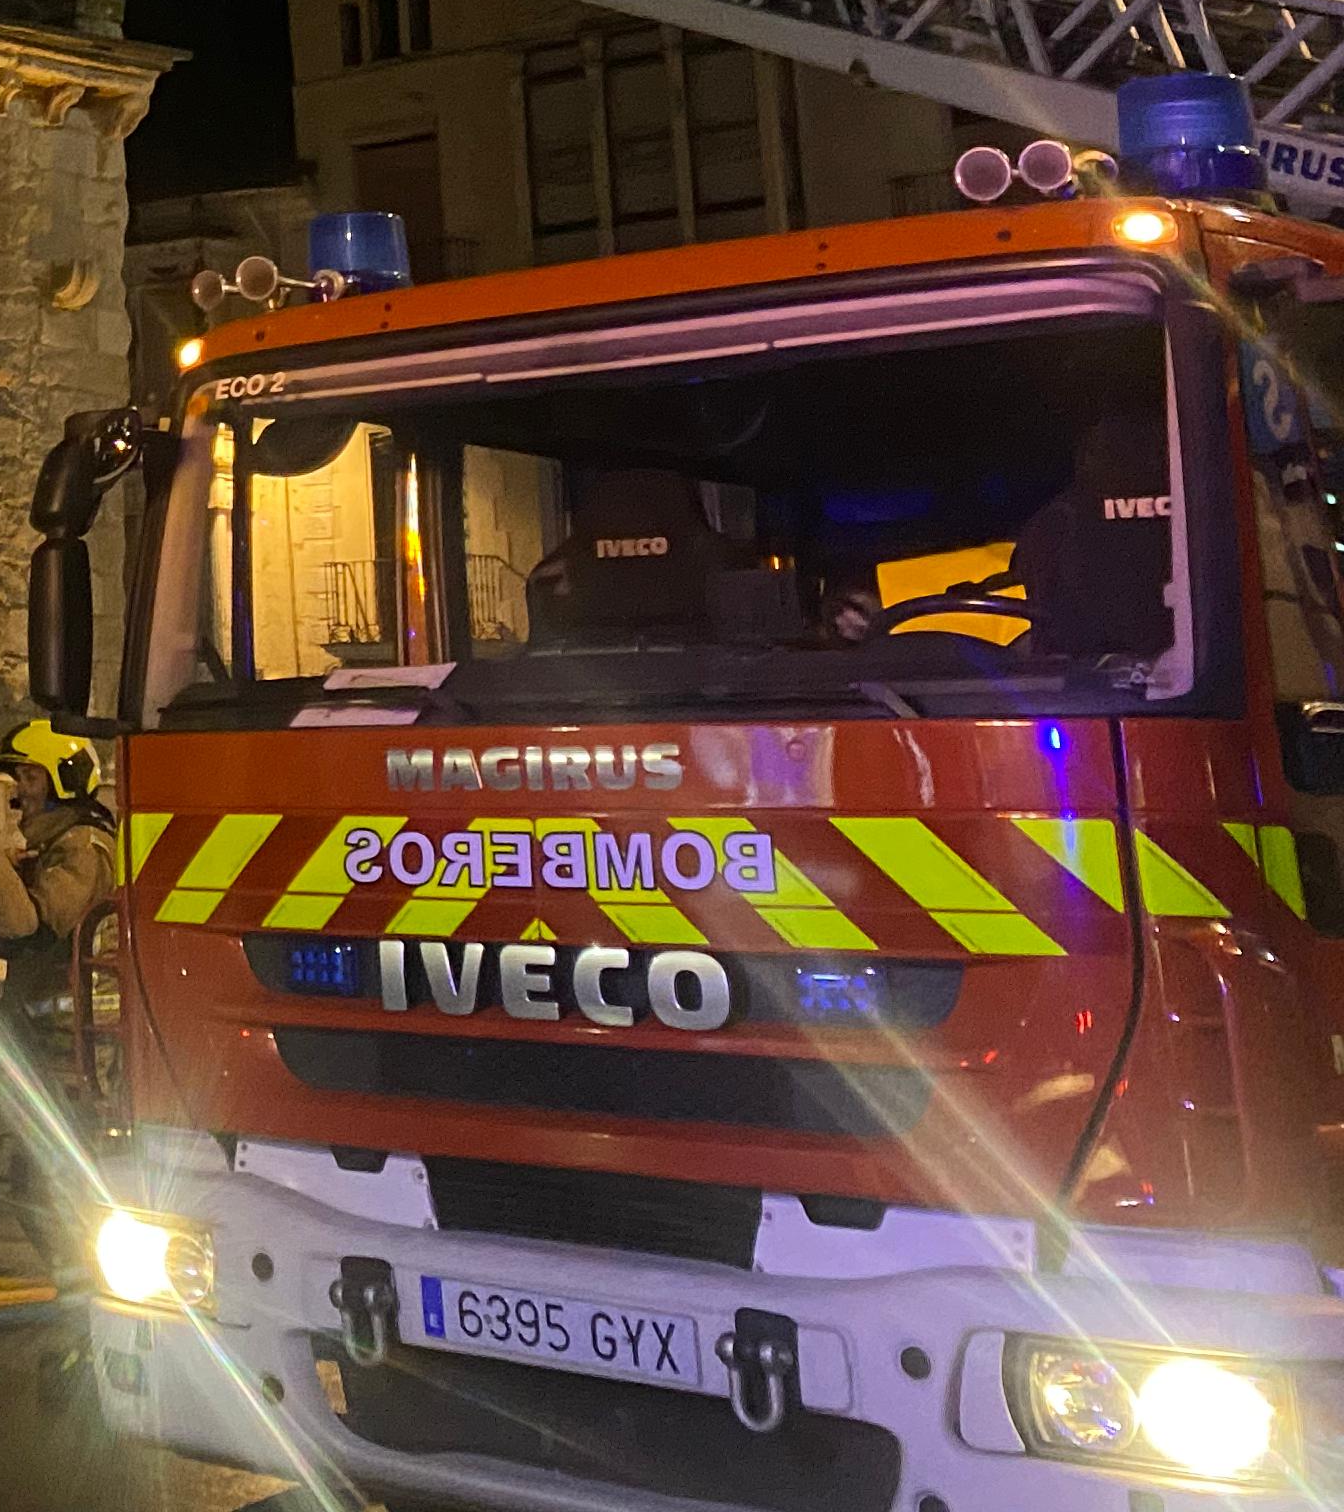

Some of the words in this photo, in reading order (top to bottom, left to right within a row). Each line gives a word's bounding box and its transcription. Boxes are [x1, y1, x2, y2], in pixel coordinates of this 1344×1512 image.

[215, 373, 265, 400] ECO
[269, 371, 287, 393] 2
[596, 536, 668, 558] IVECO
[386, 743, 683, 792] MAGIRUS
[380, 939, 731, 1031] IVECO
[457, 1291, 570, 1352] 6395
[590, 1311, 681, 1375] GYX
